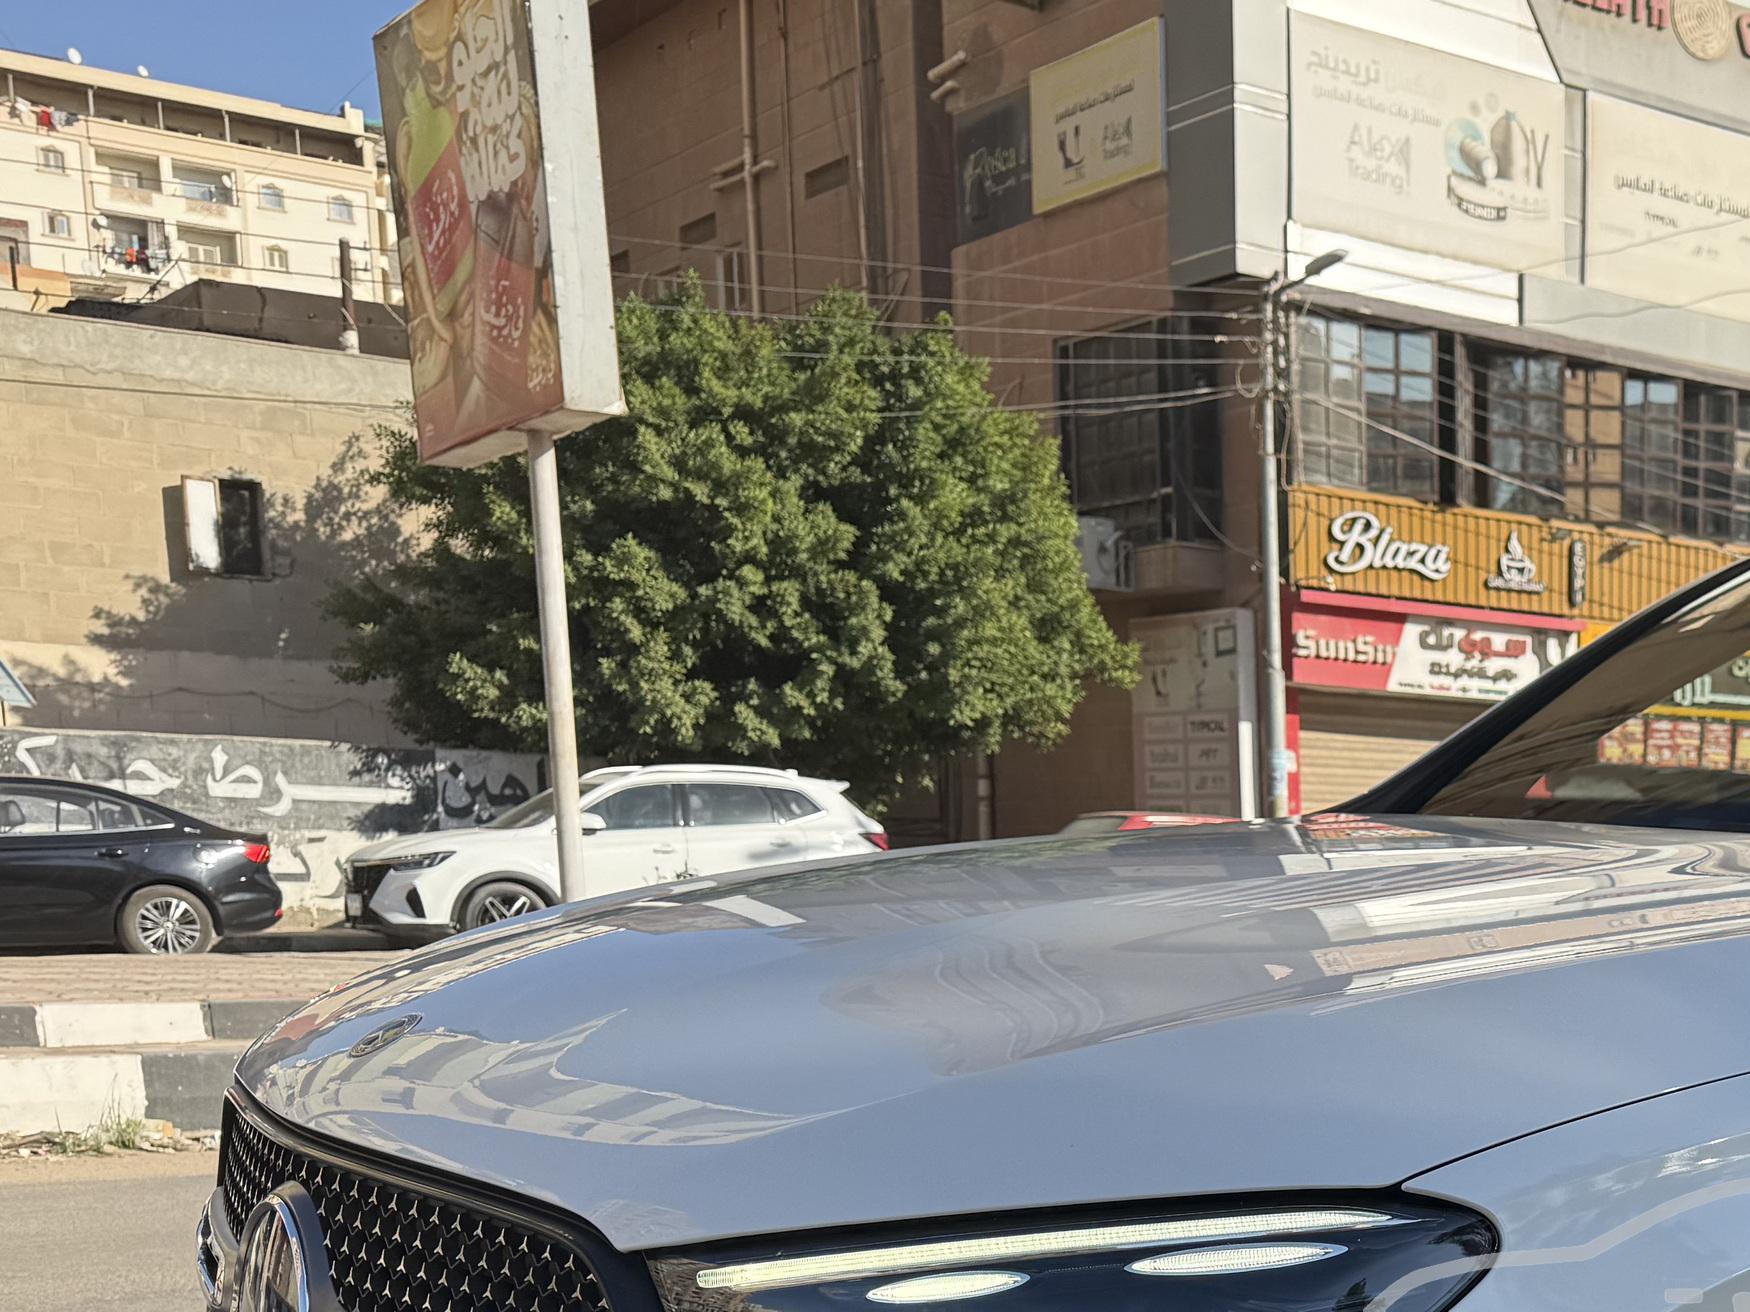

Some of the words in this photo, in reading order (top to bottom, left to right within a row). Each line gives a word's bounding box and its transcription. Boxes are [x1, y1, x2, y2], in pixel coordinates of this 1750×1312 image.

[1306, 46, 1381, 86] تريدينج
[1345, 157, 1405, 194] Trading
[1326, 511, 1451, 580] Blaza
